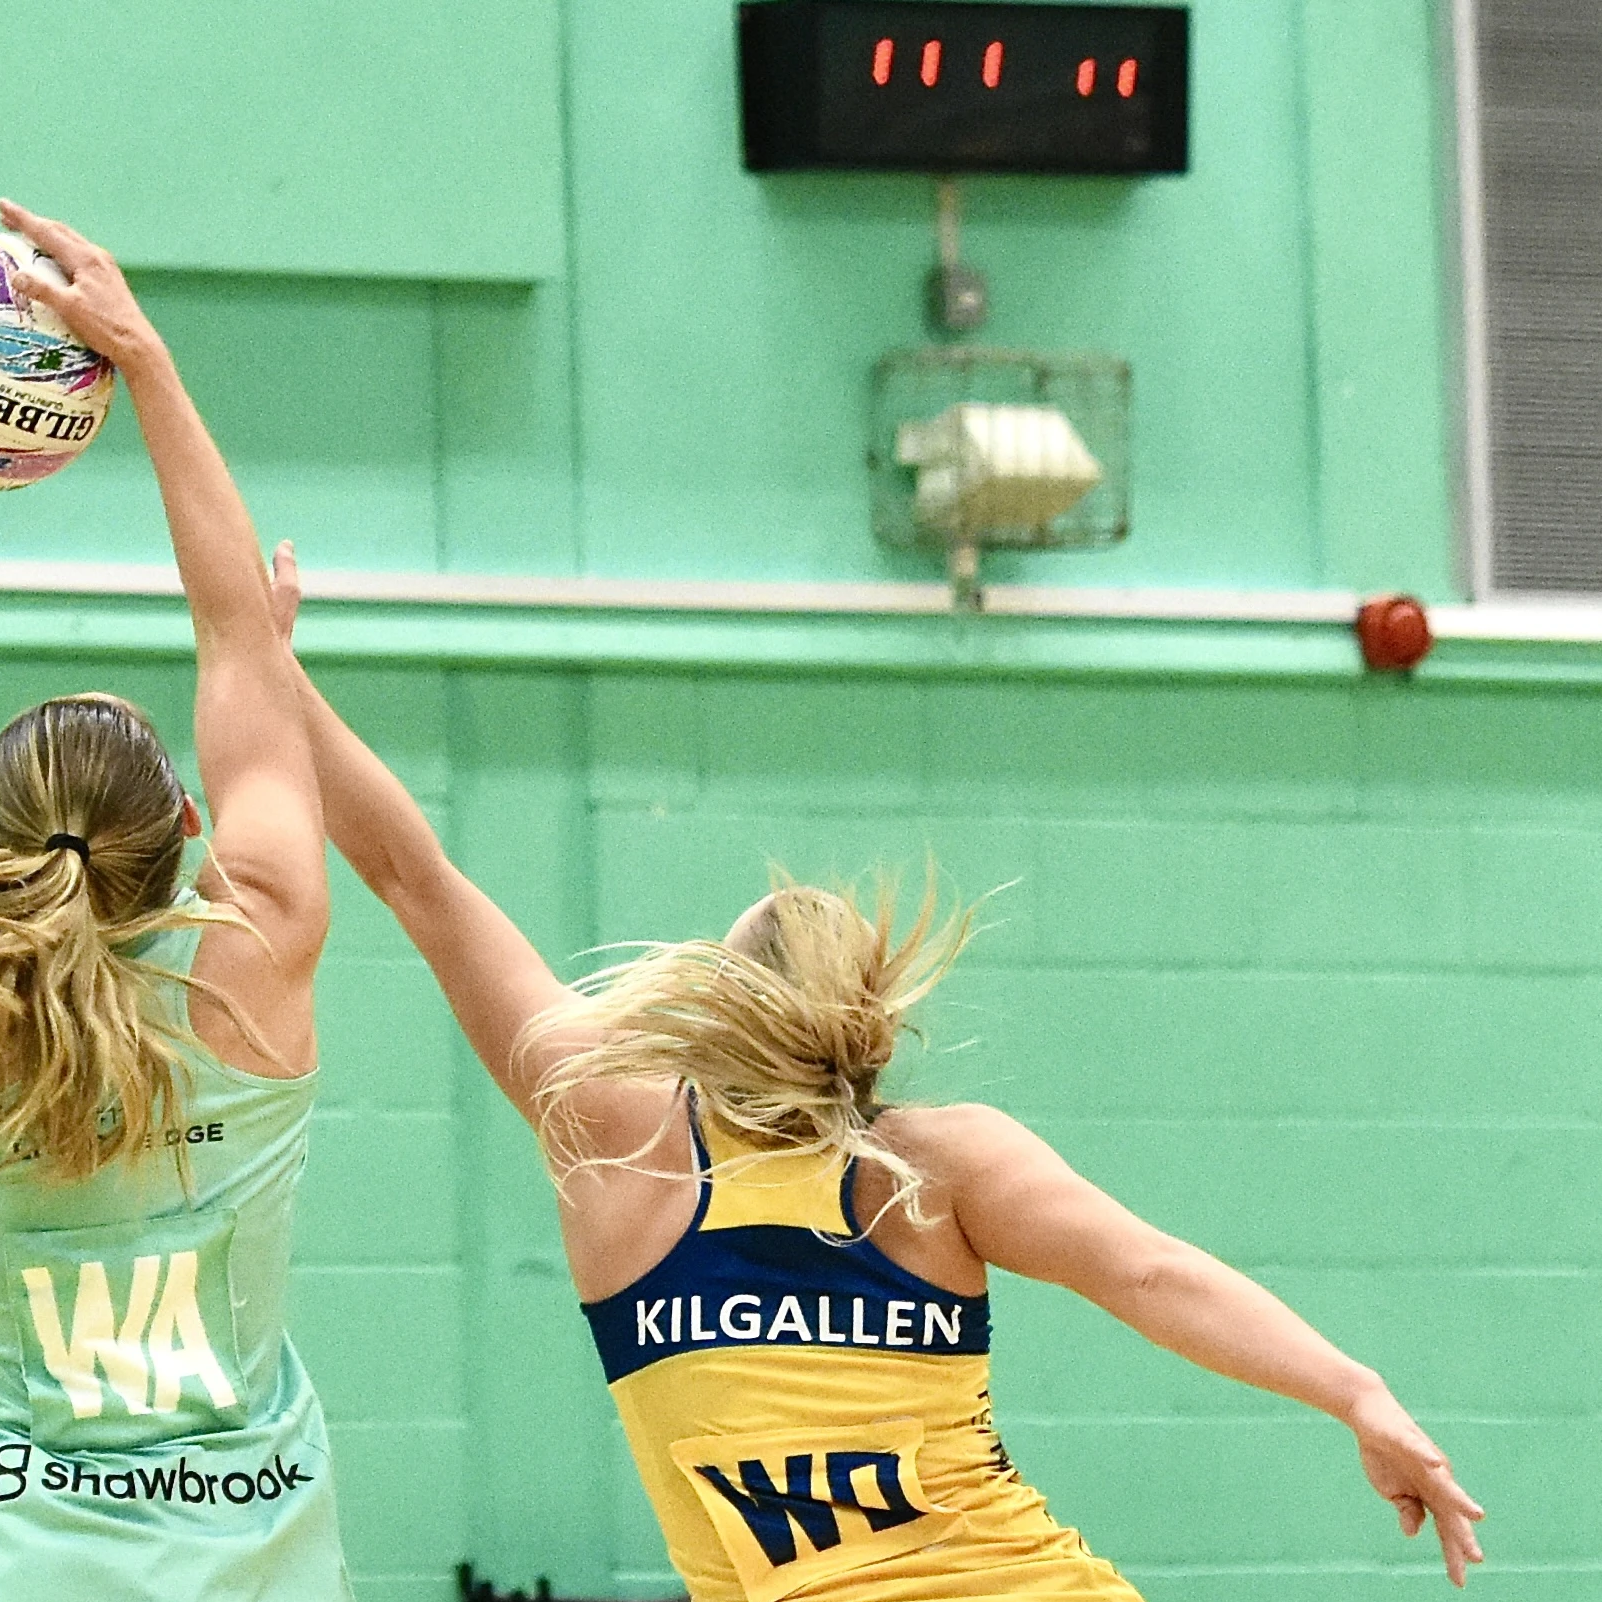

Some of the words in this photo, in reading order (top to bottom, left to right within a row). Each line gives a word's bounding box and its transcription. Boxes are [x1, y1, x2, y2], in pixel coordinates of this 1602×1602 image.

[20, 1250, 238, 1420] WA
[636, 1293, 962, 1346] KILGALLEN
[41, 1453, 315, 1506] shawbrook
[694, 1451, 930, 1568] WD
